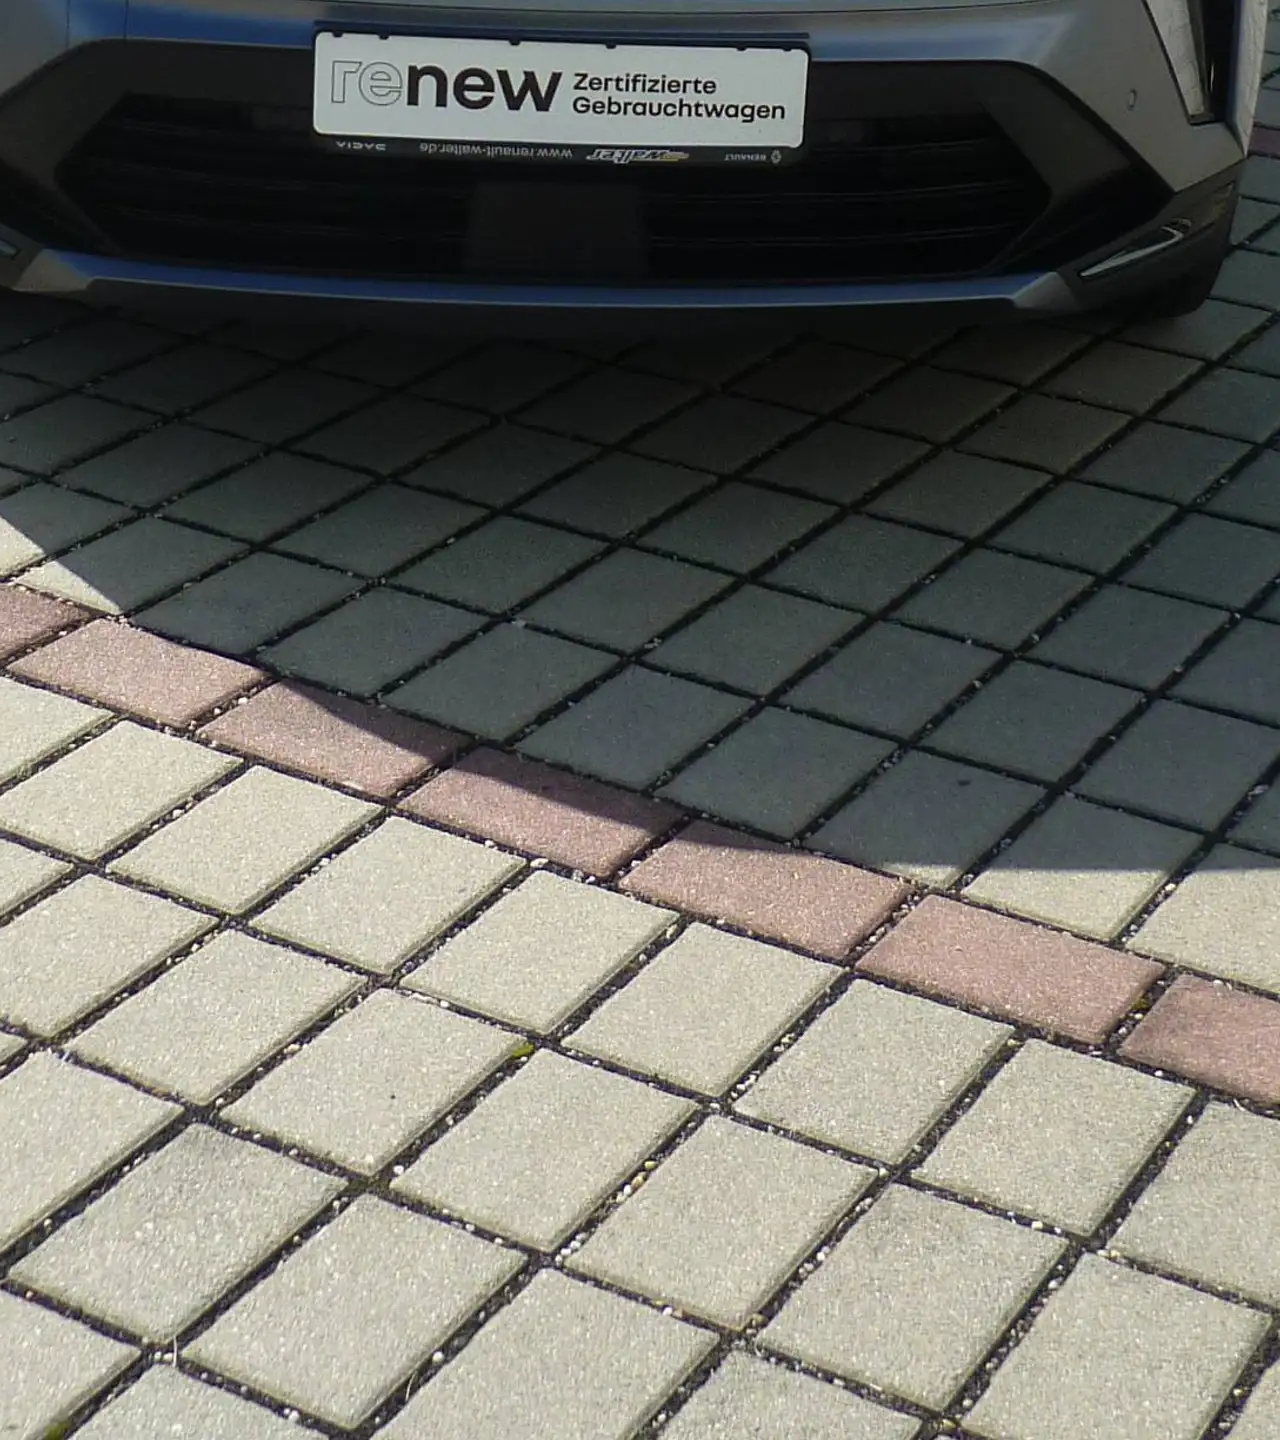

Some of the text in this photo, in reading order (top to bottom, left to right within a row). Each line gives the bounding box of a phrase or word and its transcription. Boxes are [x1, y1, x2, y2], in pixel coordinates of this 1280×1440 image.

[331, 60, 563, 112] renew
[573, 72, 717, 94] Zertifizierte
[572, 96, 786, 123] Gebrauchtwagen
[419, 142, 574, 160] www.renault-walter.de
[724, 153, 767, 162] RENAULT
